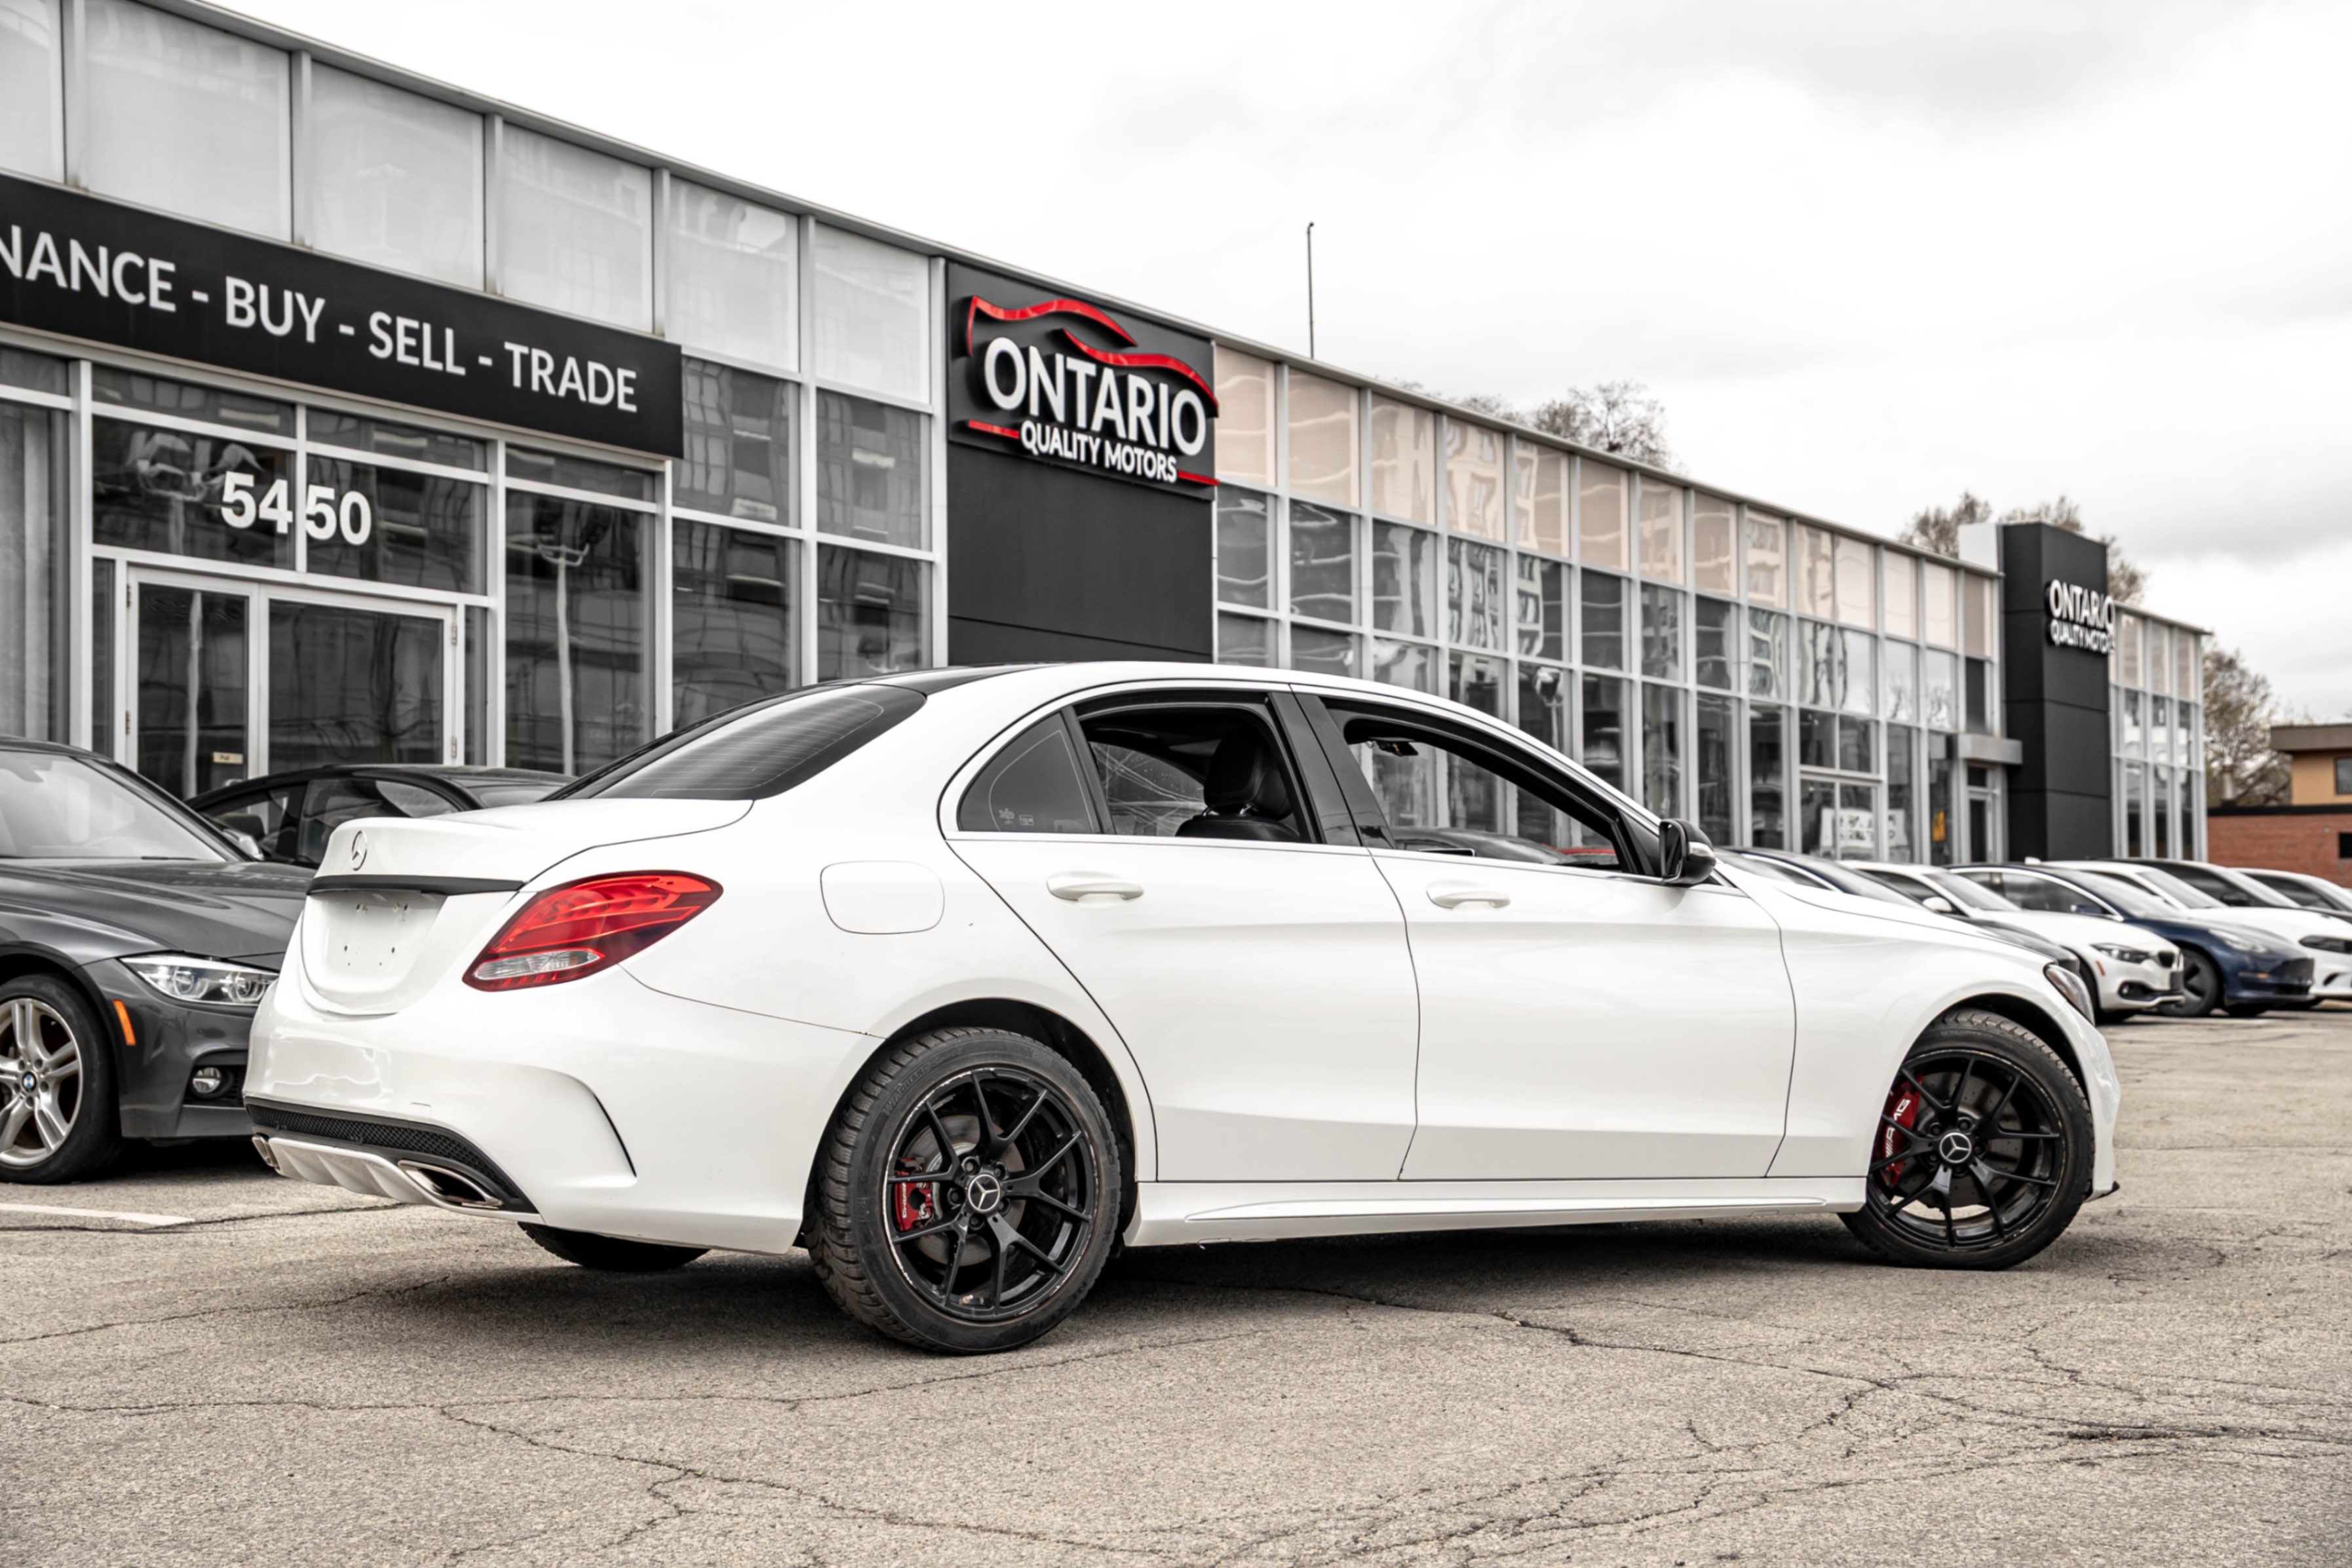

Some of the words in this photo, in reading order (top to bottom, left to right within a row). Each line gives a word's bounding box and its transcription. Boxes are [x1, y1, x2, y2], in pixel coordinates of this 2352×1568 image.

[225, 276, 326, 343] BUY
[368, 311, 466, 375] SELL
[504, 341, 637, 412] TRADE
[984, 337, 1206, 456] ONTARIO
[1020, 419, 1101, 465] QUALITY
[1104, 440, 1177, 484] MOTORS
[221, 470, 372, 547] 5450
[2049, 579, 2115, 630] ONTARIO
